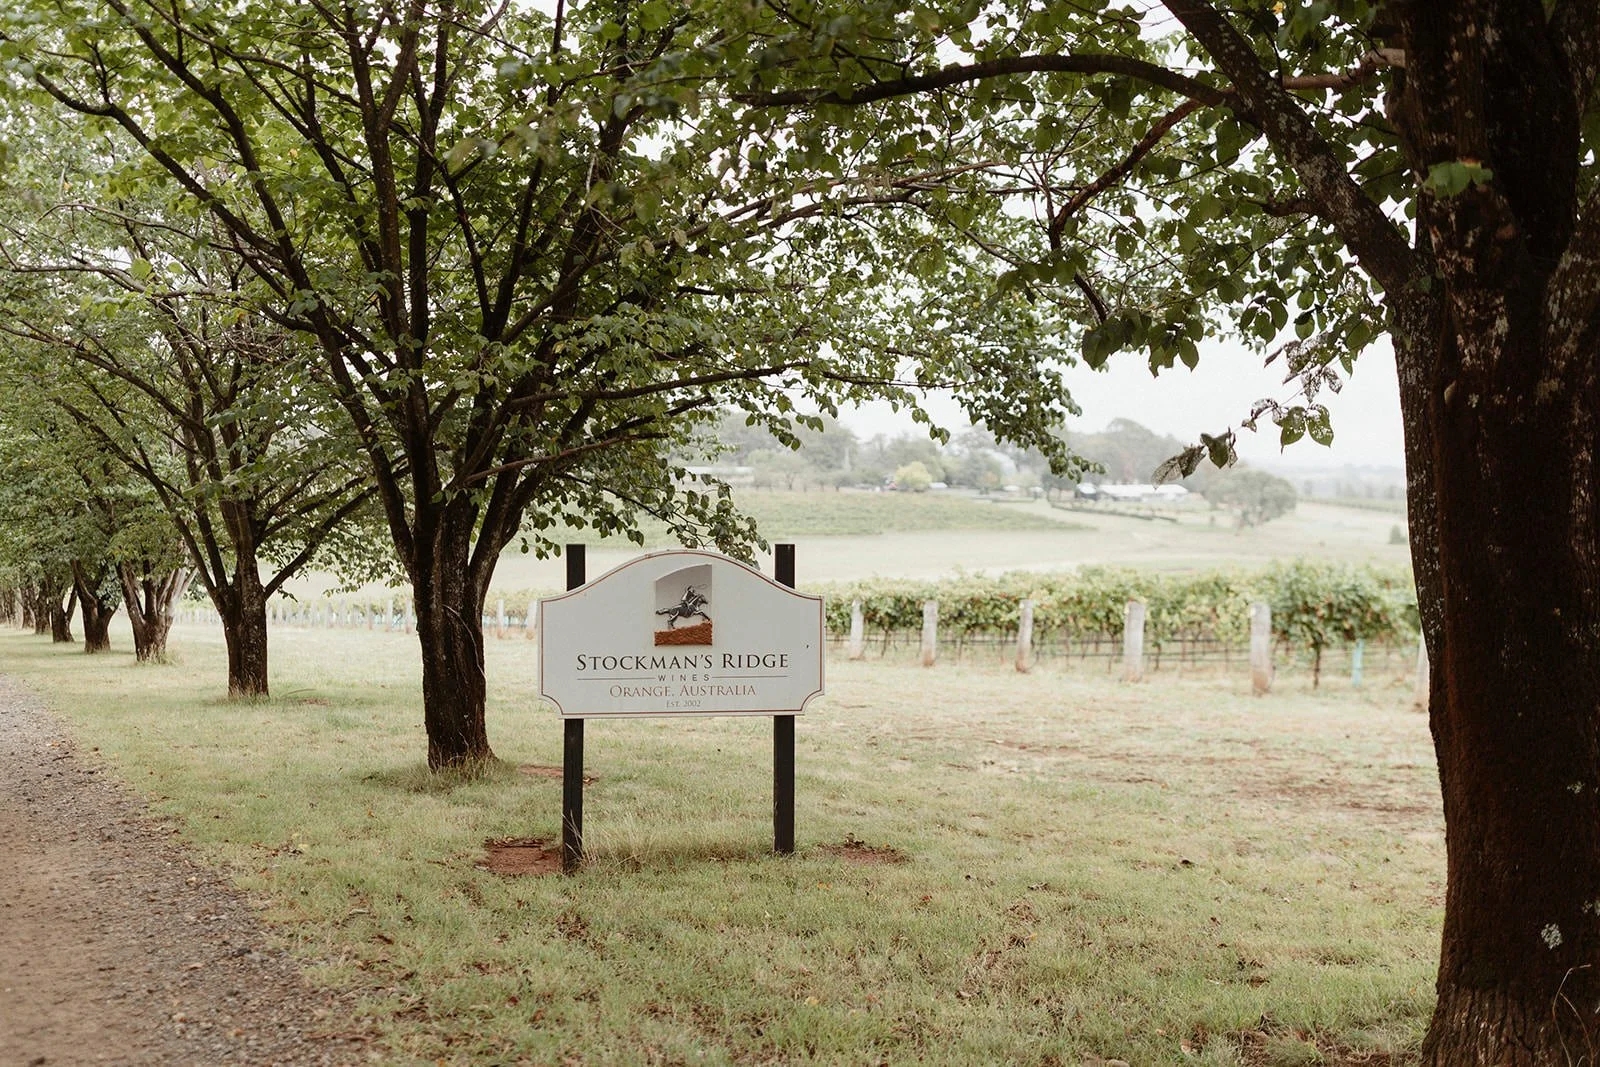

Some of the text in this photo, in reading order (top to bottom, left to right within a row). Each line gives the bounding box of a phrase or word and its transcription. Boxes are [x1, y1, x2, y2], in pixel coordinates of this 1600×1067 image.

[576, 653, 789, 671] STOCKMAN'S RIDGE
[658, 674, 711, 682] WINES
[679, 684, 757, 697] AUSTRALIA
[683, 700, 702, 708] 2002
